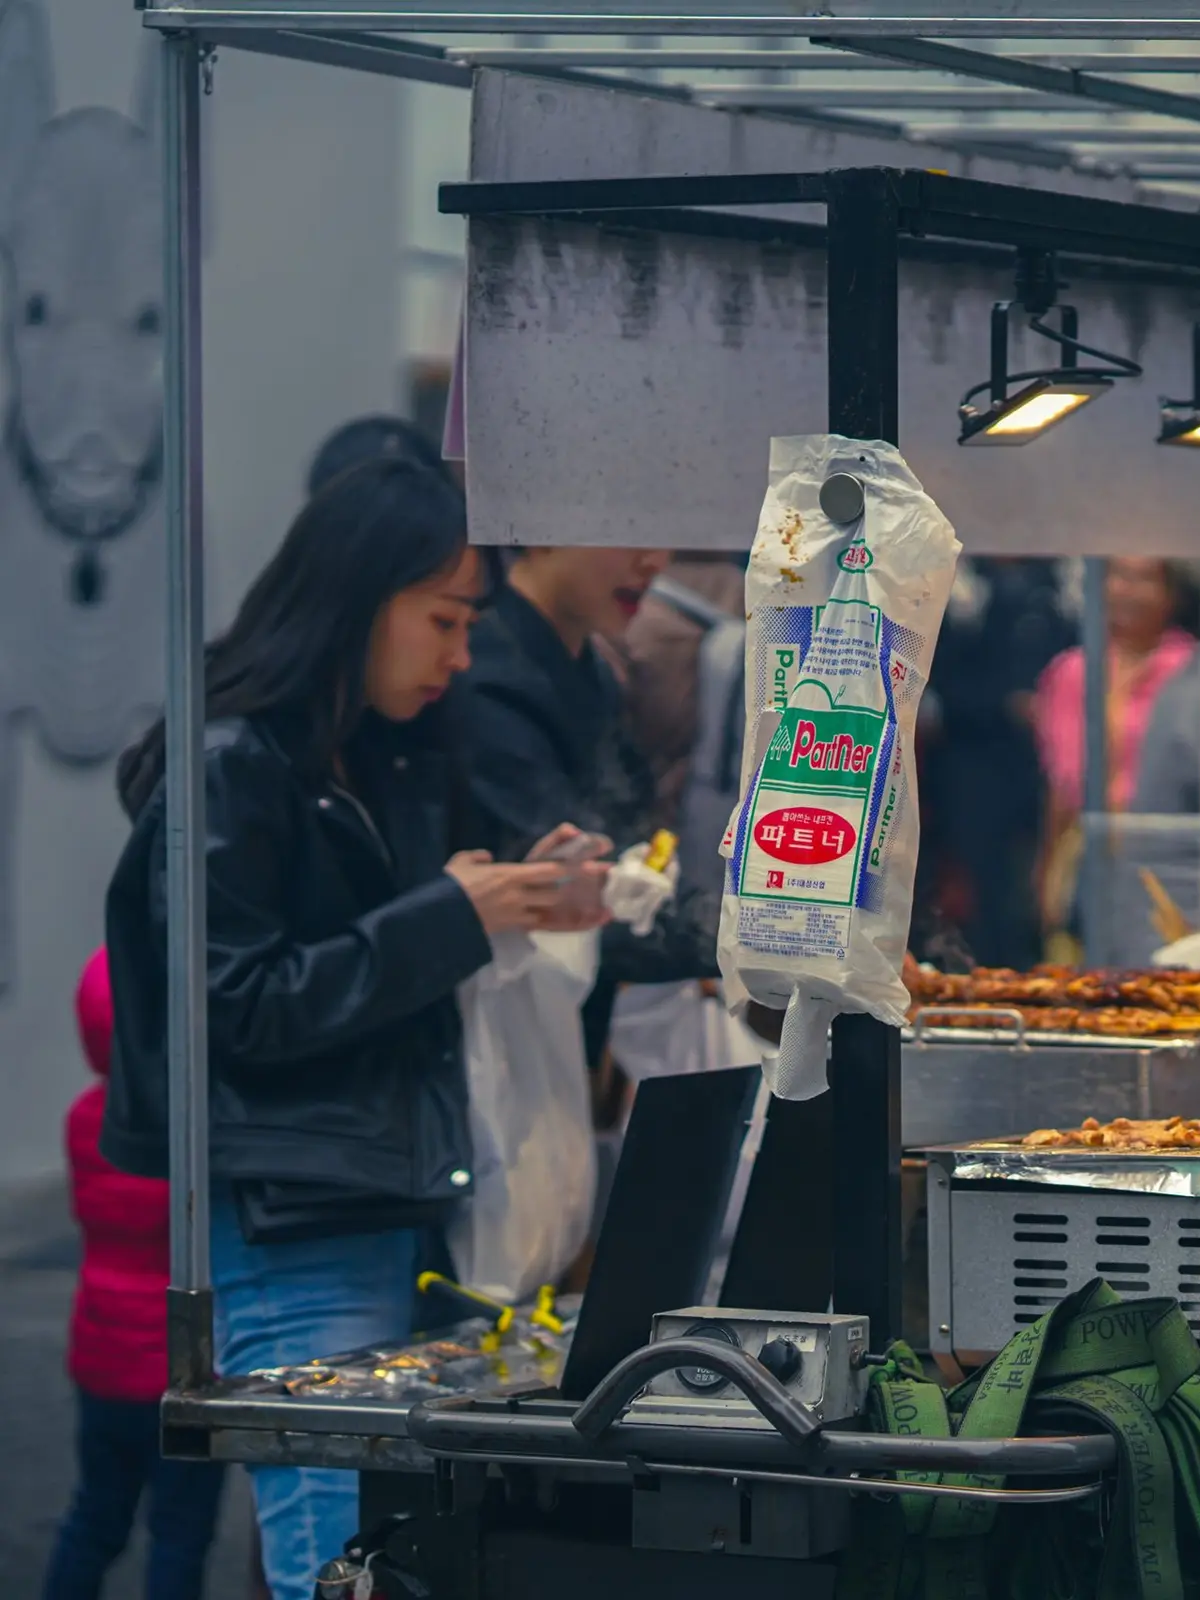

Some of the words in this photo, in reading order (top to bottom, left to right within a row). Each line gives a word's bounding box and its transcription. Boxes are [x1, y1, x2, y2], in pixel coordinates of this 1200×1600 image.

[789, 719, 874, 773] Partner
[760, 824, 846, 855] 파트너
[1124, 1422, 1156, 1526] POWER
